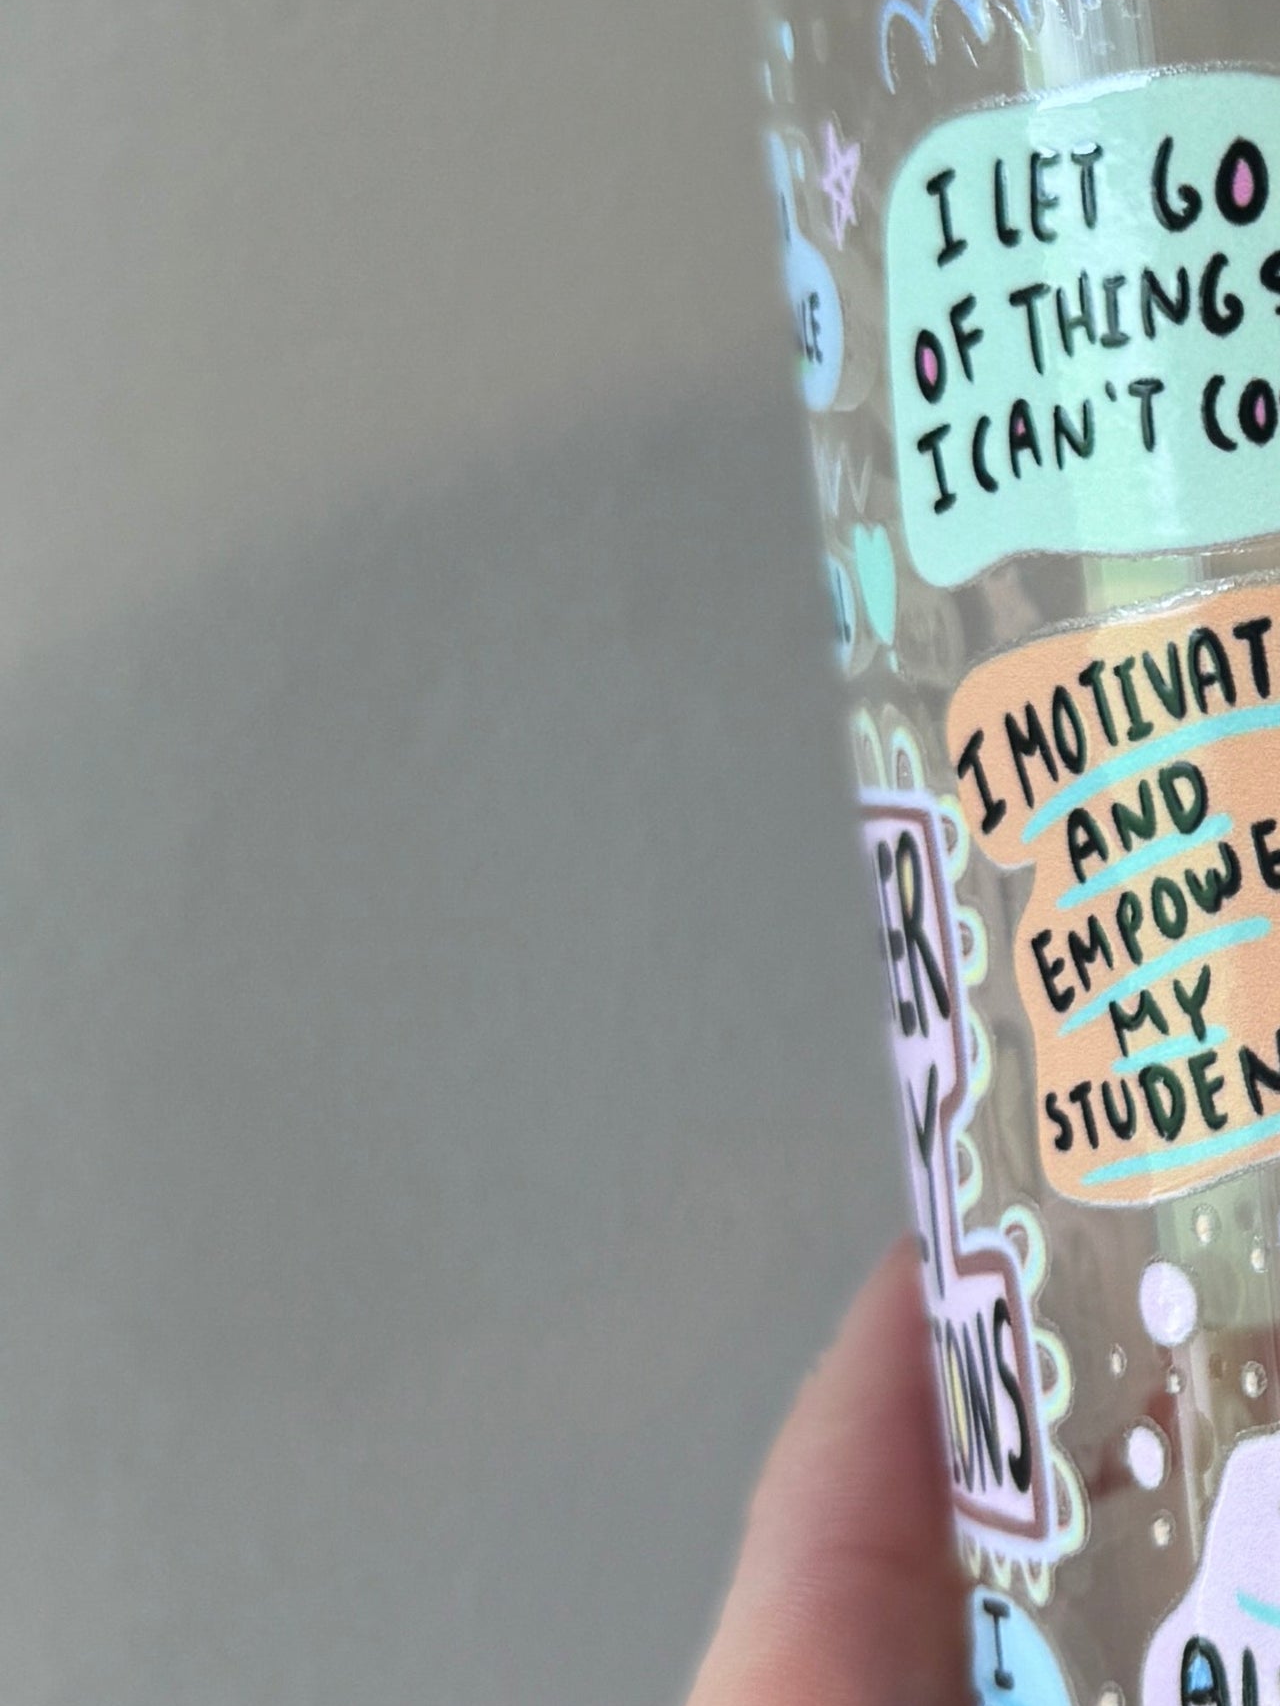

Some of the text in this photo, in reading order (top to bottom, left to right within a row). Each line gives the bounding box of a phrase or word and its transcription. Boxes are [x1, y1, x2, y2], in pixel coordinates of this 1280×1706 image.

[926, 135, 1269, 267] I LET GO
[914, 295, 985, 403] OF
[917, 423, 957, 515] I
[972, 377, 1165, 494] CAN'T
[958, 729, 1006, 834] I
[1067, 760, 1209, 884] AND
[1109, 964, 1211, 1057] MY
[983, 1598, 1015, 1691] I
